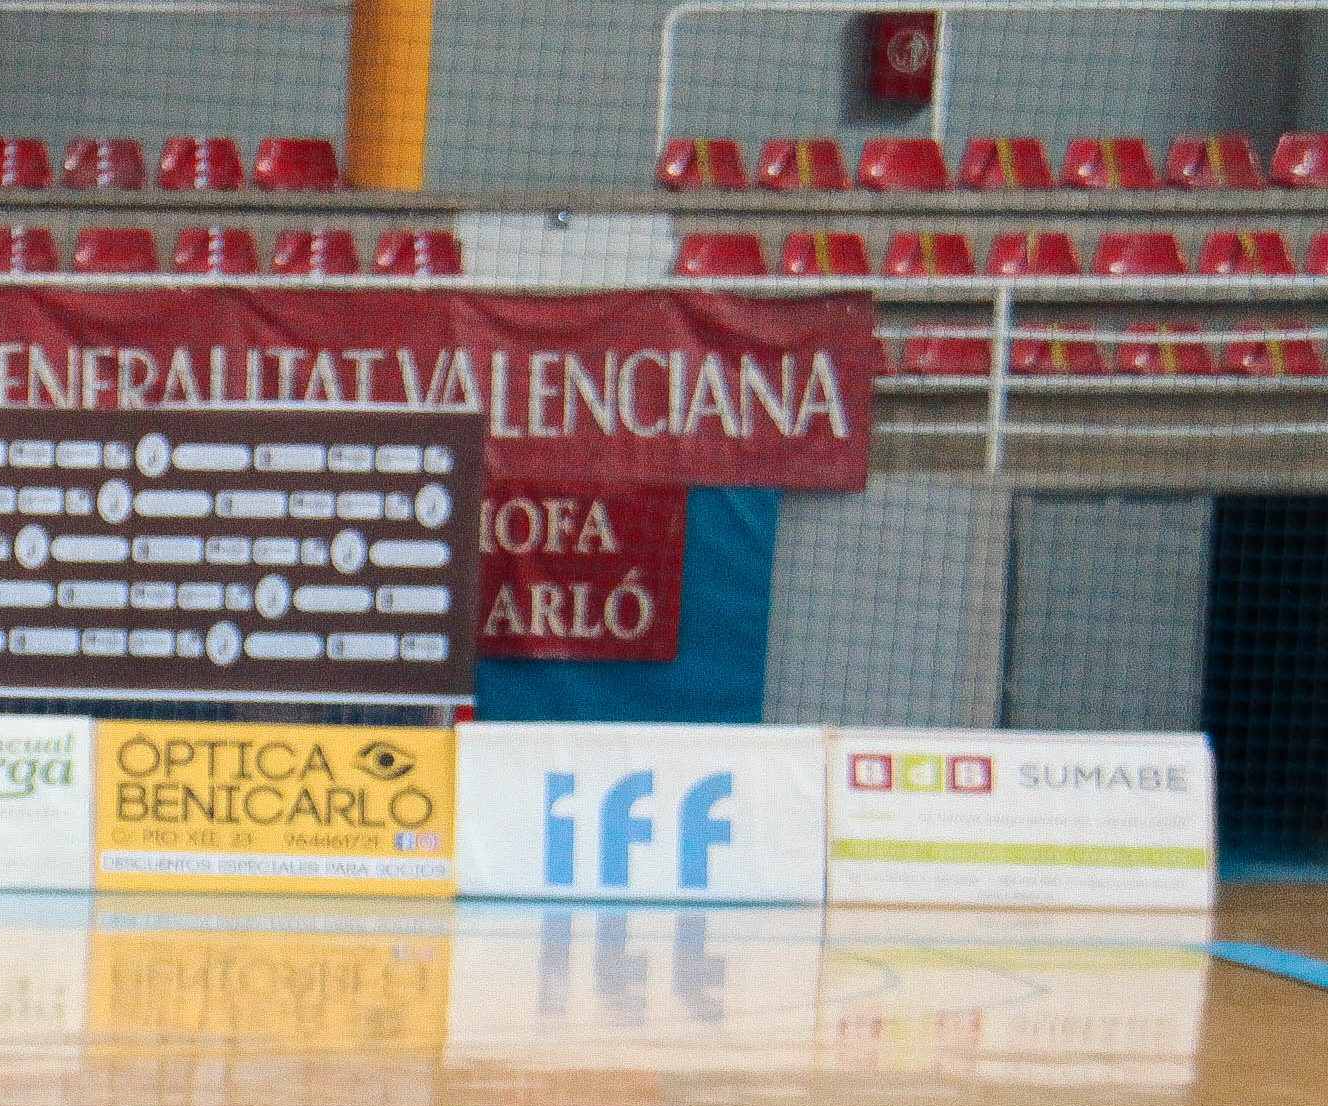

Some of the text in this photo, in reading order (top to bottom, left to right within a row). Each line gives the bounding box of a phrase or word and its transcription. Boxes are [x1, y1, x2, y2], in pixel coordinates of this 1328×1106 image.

[397, 347, 851, 438] VALENCIANA
[1017, 762, 1189, 793] SUMABE
[545, 770, 734, 888] iff
[326, 857, 369, 877] PARA
